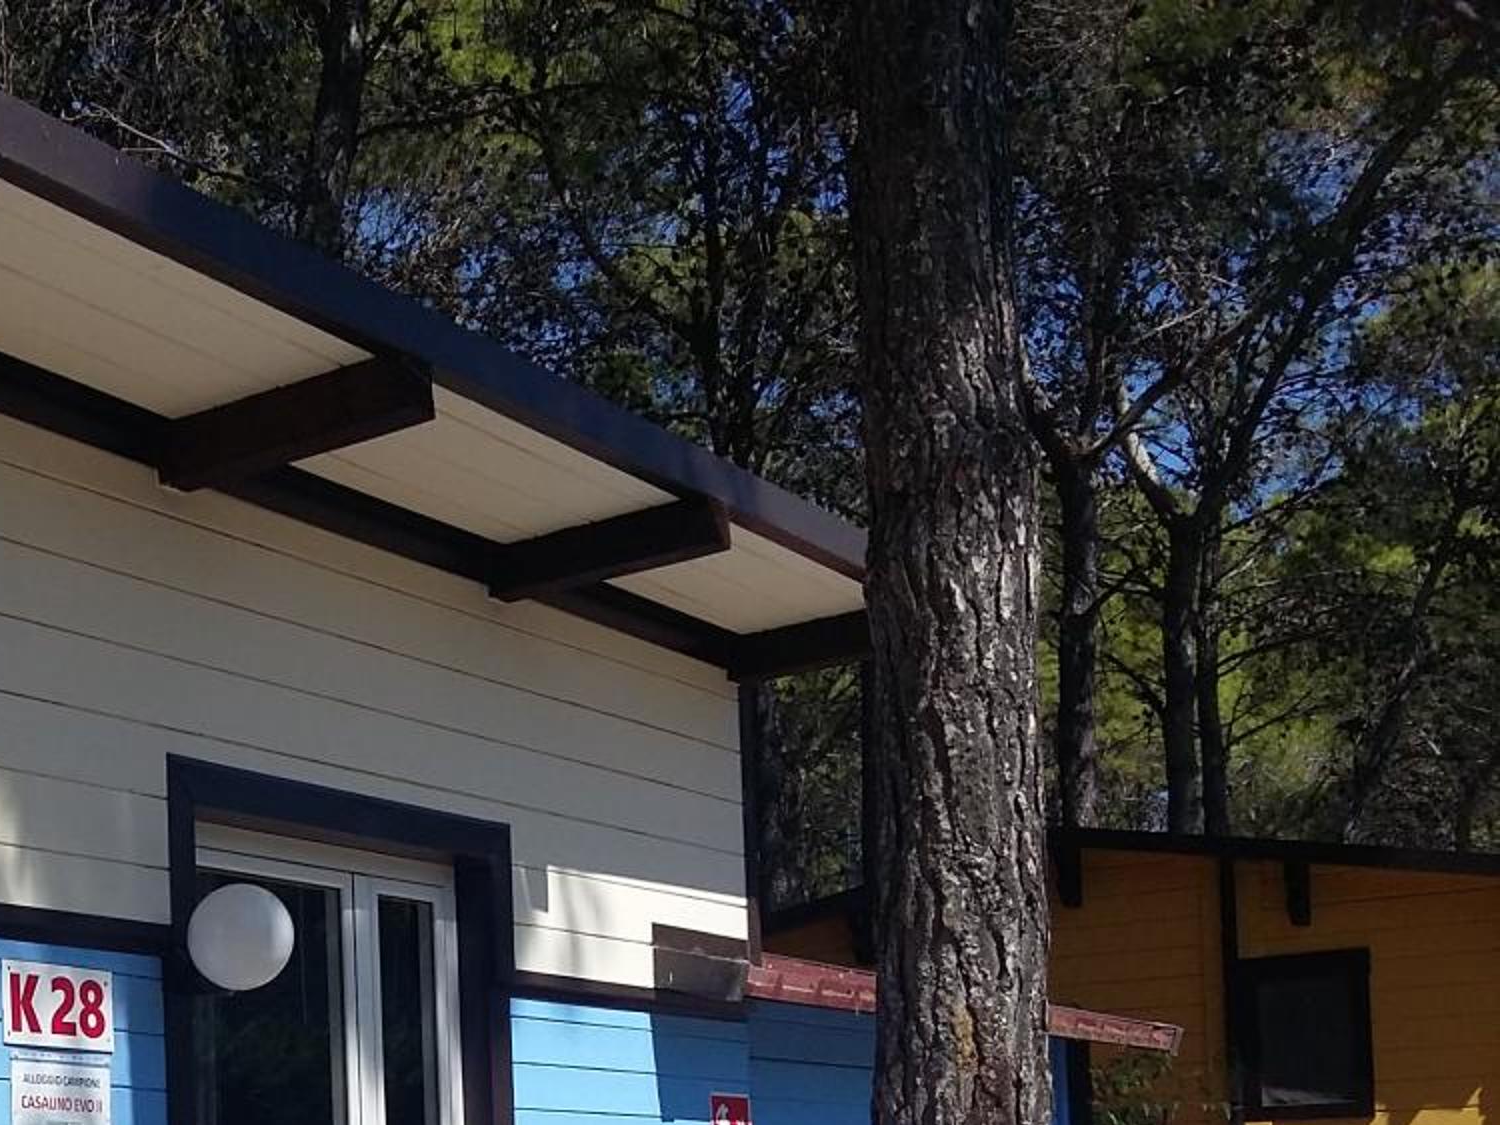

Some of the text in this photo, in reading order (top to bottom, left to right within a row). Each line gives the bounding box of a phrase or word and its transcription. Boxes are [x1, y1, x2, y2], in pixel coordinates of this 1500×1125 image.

[10, 972, 106, 1039] K 28
[23, 1074, 63, 1086] ALLOGGIO
[21, 1095, 72, 1111] CASALINO
[73, 1098, 95, 1113] EVO
